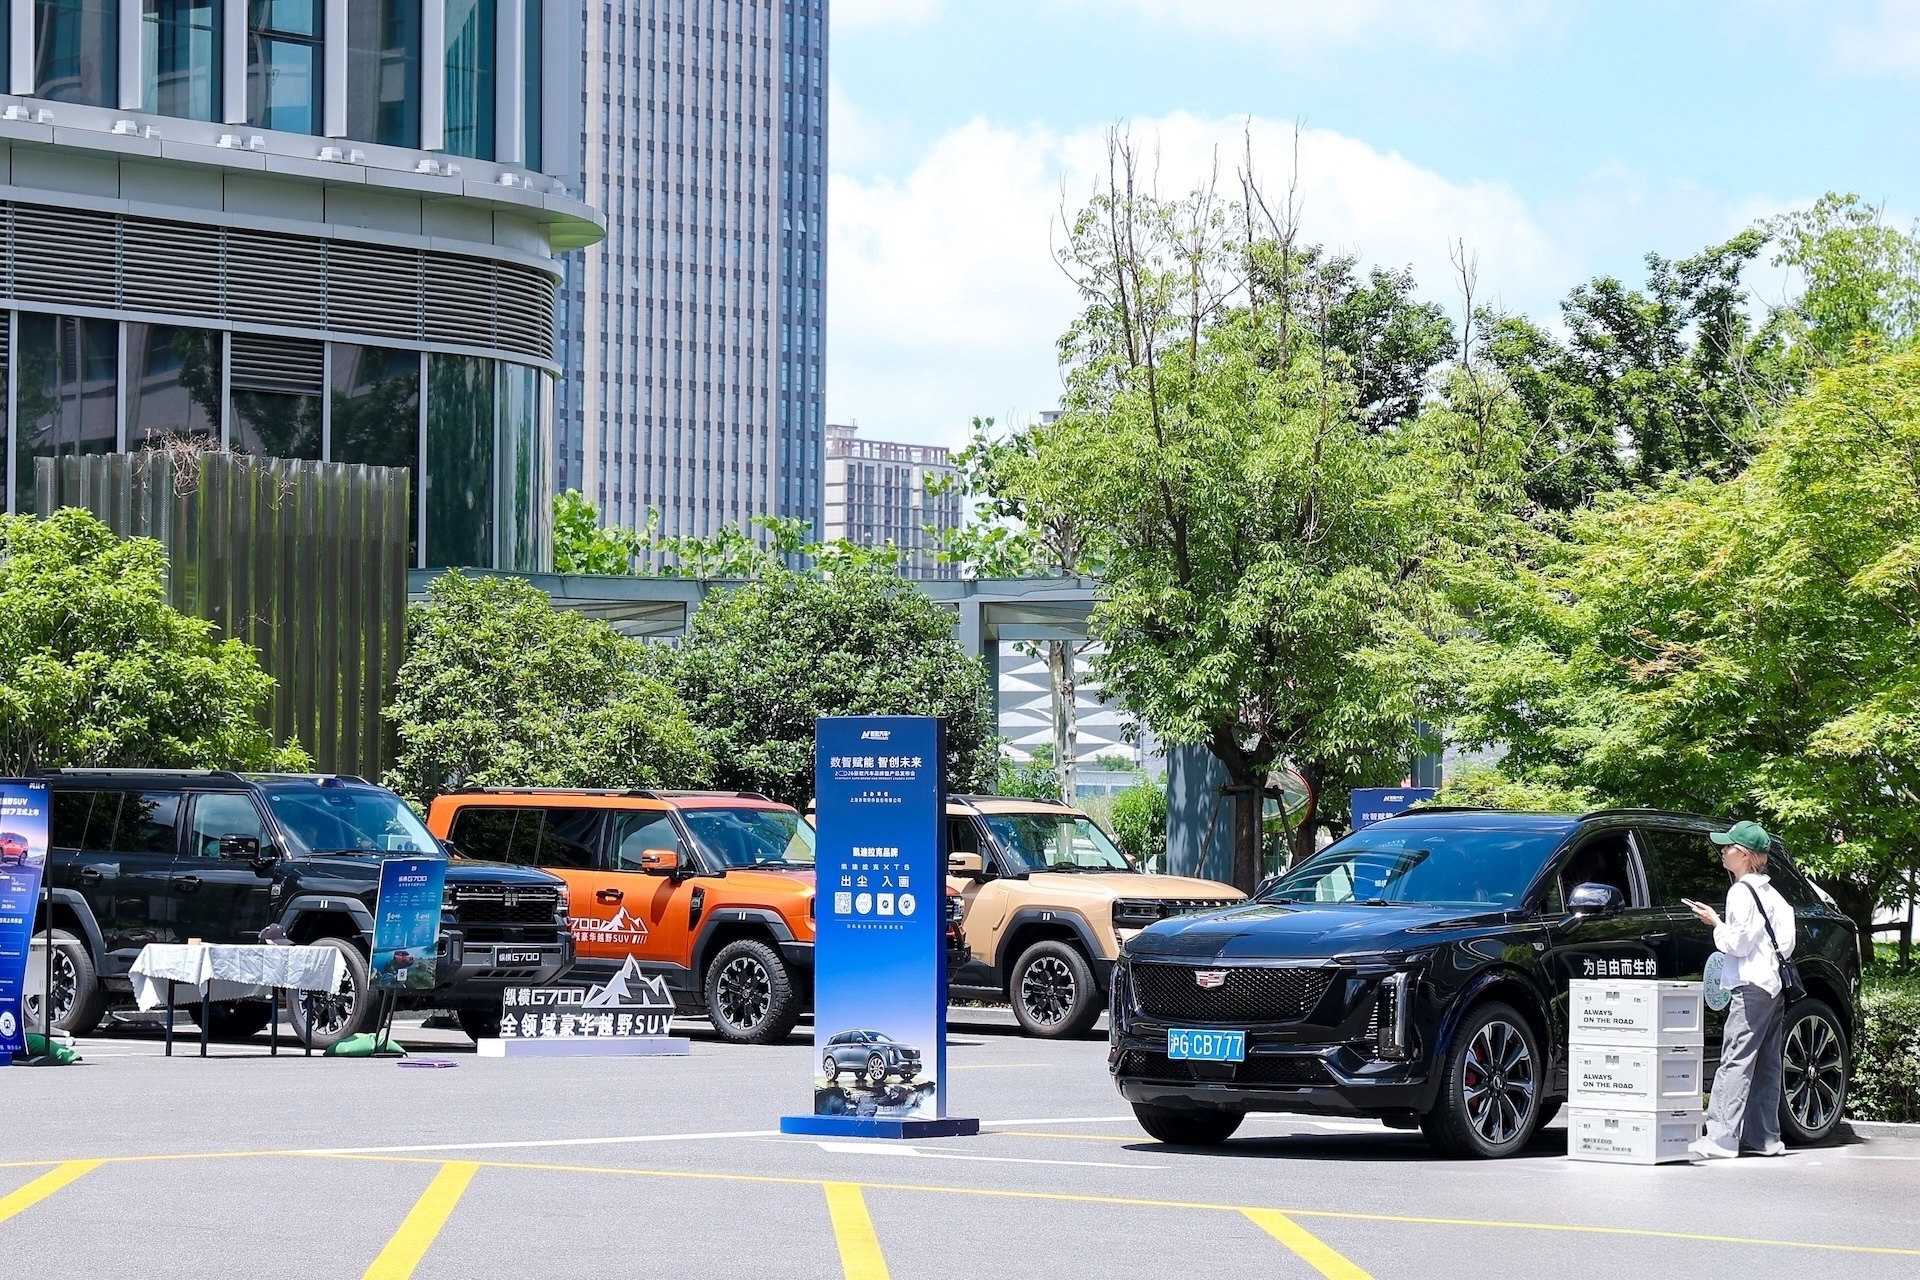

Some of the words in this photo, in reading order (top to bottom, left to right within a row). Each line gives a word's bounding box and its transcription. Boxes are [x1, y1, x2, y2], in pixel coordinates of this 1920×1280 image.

[830, 756, 874, 768] 数智赋能
[877, 756, 922, 768] 智创未来
[852, 847, 899, 857] 凯迪拉克品牌
[841, 875, 868, 887] 出尘
[882, 875, 910, 888] 入画
[498, 952, 540, 962] 纵横G700
[1583, 958, 1657, 976] 为自由而生的
[504, 988, 585, 1006] 纵横G700
[500, 1012, 674, 1038] 全领域豪华越野SUV
